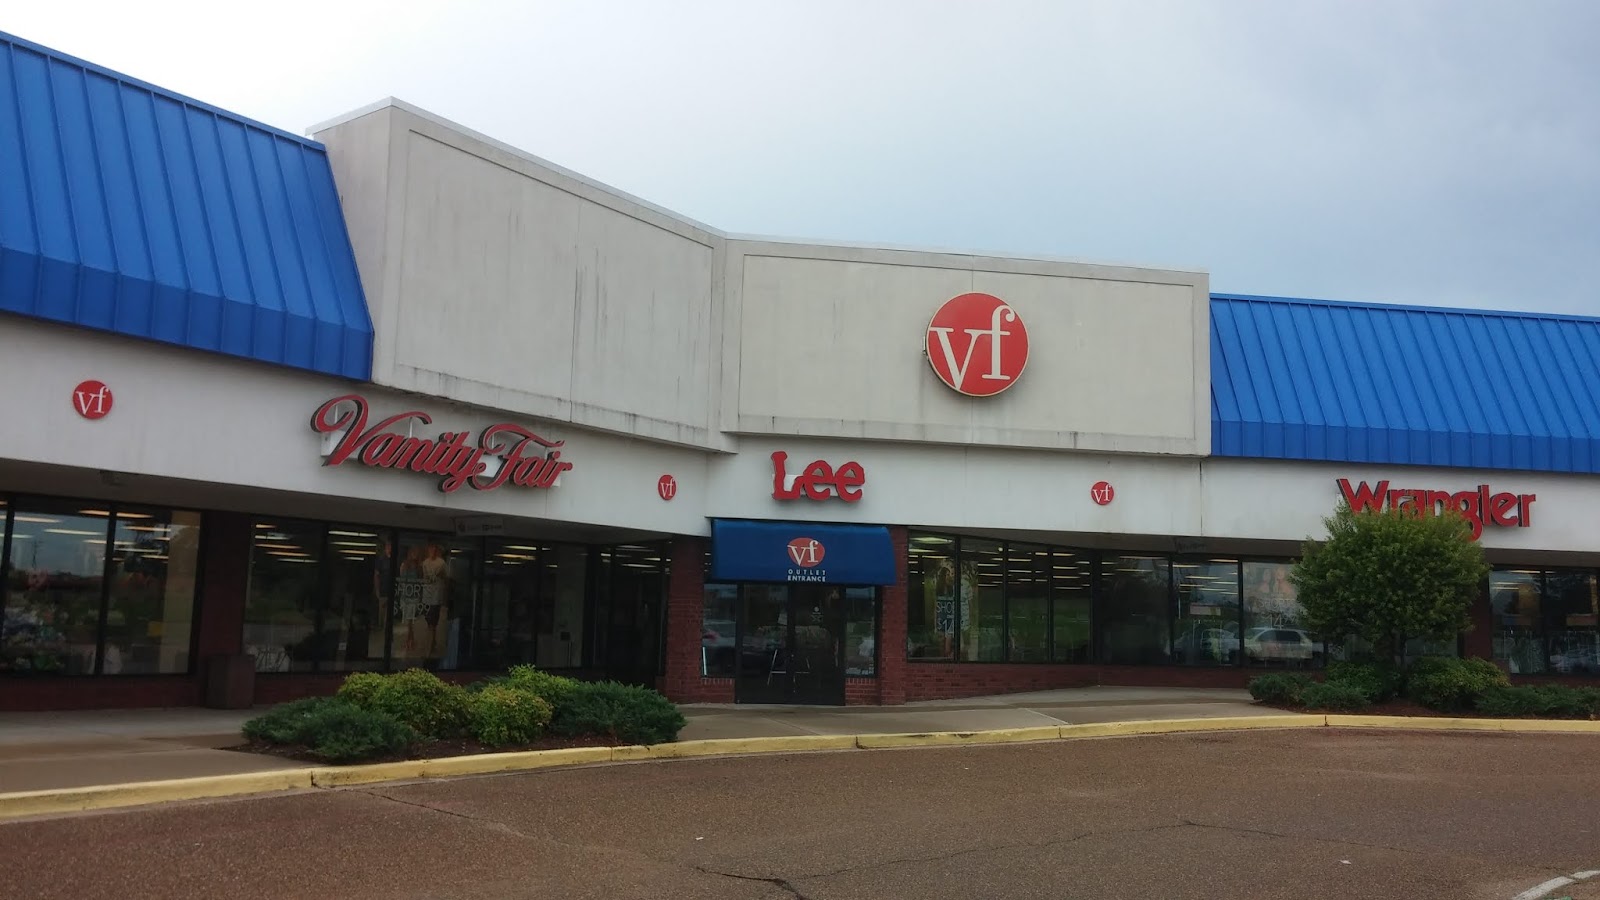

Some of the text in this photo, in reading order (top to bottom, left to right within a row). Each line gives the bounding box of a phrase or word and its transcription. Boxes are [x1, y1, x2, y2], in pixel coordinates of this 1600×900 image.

[927, 303, 1016, 391] vf
[75, 384, 109, 415] vf
[310, 394, 573, 493] Vanity Fair
[659, 477, 676, 498] vf
[770, 451, 865, 503] Lee
[1092, 483, 1112, 504] vf
[1336, 478, 1536, 542] Wrangler
[787, 539, 819, 567] vf
